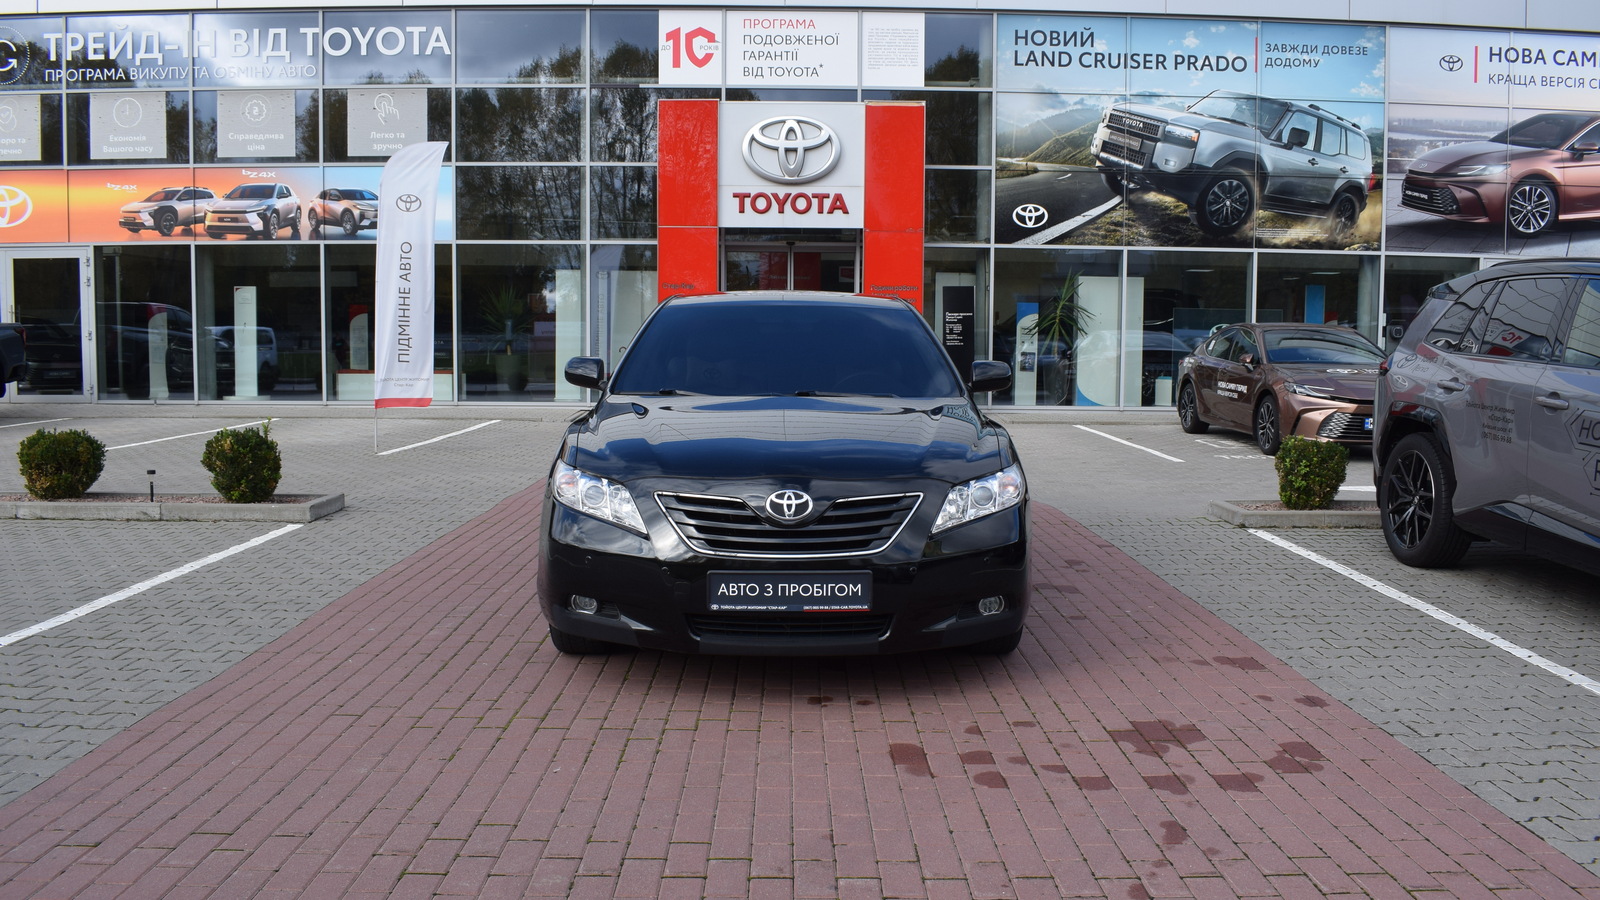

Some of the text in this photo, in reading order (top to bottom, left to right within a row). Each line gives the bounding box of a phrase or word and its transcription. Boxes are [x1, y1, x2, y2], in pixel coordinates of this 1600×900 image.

[743, 18, 816, 30] ПРОГРАМА
[743, 32, 840, 47] ПОДОВЖЕНОЇ
[1013, 27, 1095, 48] НОВИЙ
[43, 24, 452, 66] ТРЕЙД-ІН ВІД TOYOTA
[1265, 42, 1369, 57] ЗАВЖДИ ДОВЕЗЕ
[743, 48, 799, 62] ГАРАНТІЇ
[1013, 50, 1248, 73] LAND CRUISER PRADO
[1489, 46, 1600, 68] НОВА CAM
[1265, 56, 1321, 70] ДОДОМУ
[45, 64, 317, 82] ПРОГРАМА ВИКУПУ ТА ОБМІНУ АВТО
[743, 66, 764, 79] ВІД
[1488, 73, 1600, 89] КРАЩА ВЕРСІЯ С
[1122, 118, 1143, 128] TOYOTA
[109, 134, 147, 142] Економія
[228, 132, 284, 141] Справедлива
[370, 131, 394, 139] Легко
[103, 145, 154, 154] Вашого часу
[247, 143, 265, 152] ціна
[372, 143, 403, 152] зручно
[732, 191, 850, 215] TOYOTA
[397, 241, 413, 363] ПІДМІННЕ АВТО
[717, 583, 862, 597] АВТО З ПРОБІГОМ
